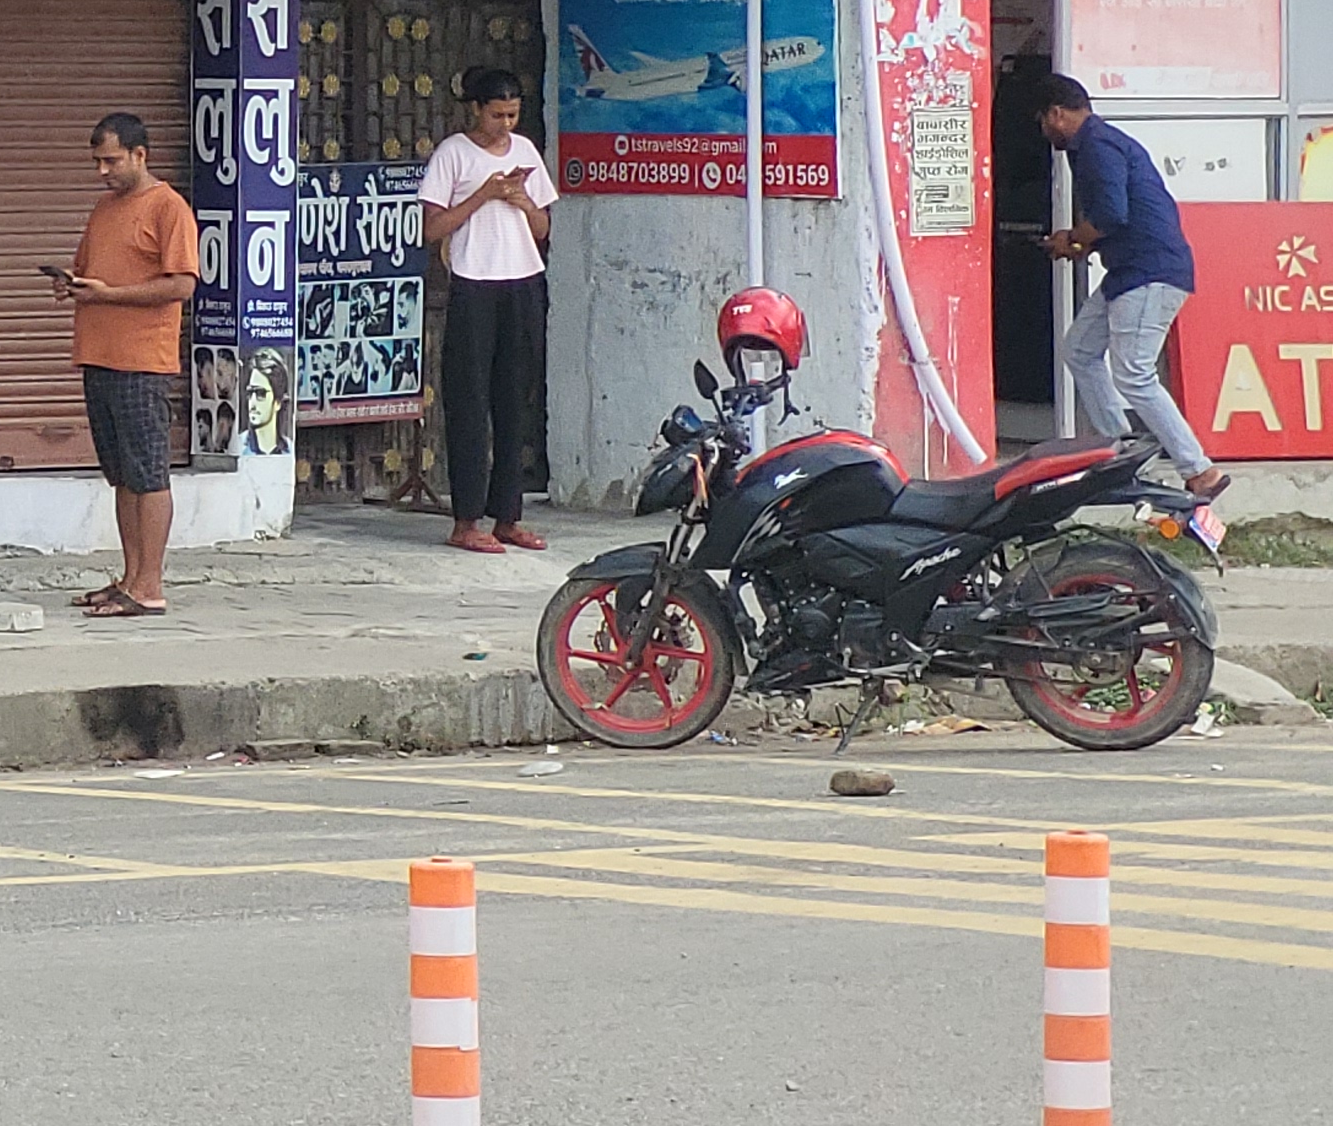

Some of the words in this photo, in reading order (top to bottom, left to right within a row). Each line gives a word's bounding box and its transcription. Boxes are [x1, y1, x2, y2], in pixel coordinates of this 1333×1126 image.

[587, 161, 689, 186] 9848703899
[355, 173, 425, 267] सैलुन
[1244, 284, 1293, 313] NIC
[899, 546, 963, 581] Apache
